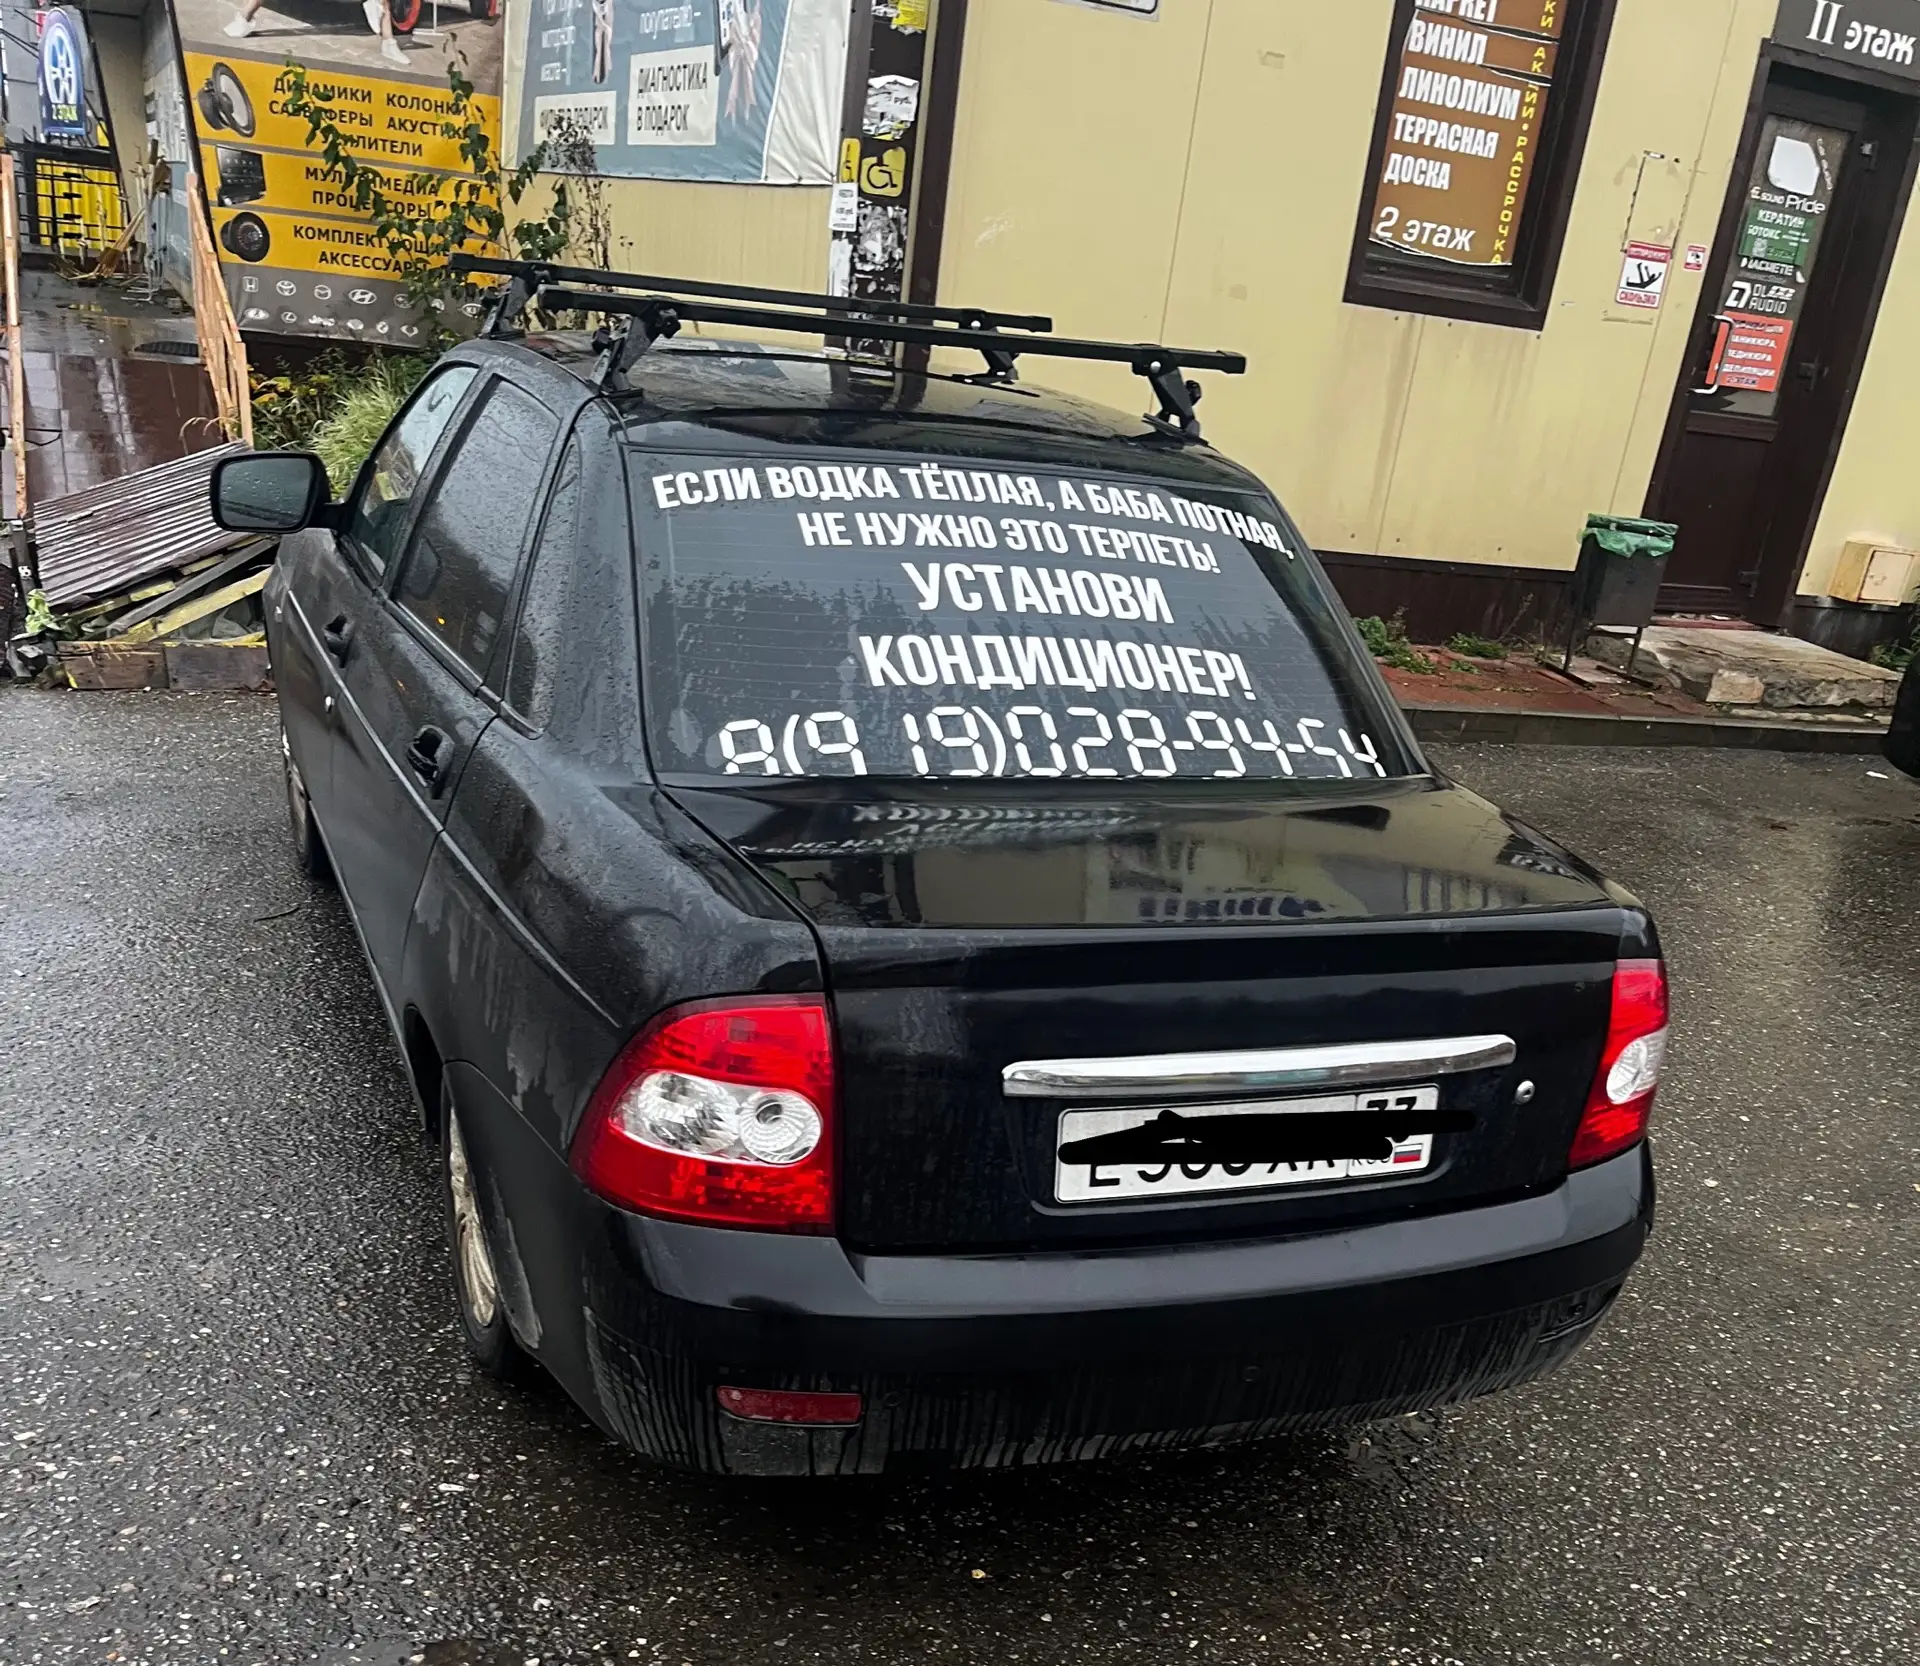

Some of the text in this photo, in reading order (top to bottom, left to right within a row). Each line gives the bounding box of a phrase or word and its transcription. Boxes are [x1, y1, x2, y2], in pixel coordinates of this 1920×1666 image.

[1408, 19, 1488, 65] ВИНИЛ
[1843, 20, 1917, 65] этаж
[637, 62, 708, 99] ДИАГНОСТИКА
[1398, 66, 1521, 121] ЛИНОЛИУМ
[1522, 46, 1546, 119] АКИИ
[268, 100, 473, 140] САВФЕРЫ АКУСТК
[386, 92, 467, 118] КОЛОНКИ
[644, 104, 690, 136] ПОДАРОК
[321, 128, 423, 157] ЛИТЕЛИ
[1394, 112, 1499, 159] ТЕРРАСНАЯ
[305, 166, 439, 196] МУЛМЕДИА
[1383, 152, 1451, 190] ДОСКА
[312, 190, 431, 218] ПРОЦЕСОРЫ
[1490, 136, 1528, 264] РАССРОЧКА
[1757, 209, 1806, 229] КЕРАТИН
[1784, 194, 1826, 215] Pride
[293, 225, 450, 257] КОМПЛЕКТЮЩ
[1375, 206, 1476, 252] 2 этаж
[1748, 297, 1788, 314] AUDIO
[652, 462, 1295, 560] ЕСЛИ ВОДКА ТЁПЛАЯ, А БАБА ПОТНАЯ,
[797, 511, 1222, 574] НЕ НУЖНО ЭТО ТЕРПЕТЬ!
[901, 561, 1176, 625] УСТАНОВИ
[859, 635, 1257, 701] КОНДИЦИОНЕР!
